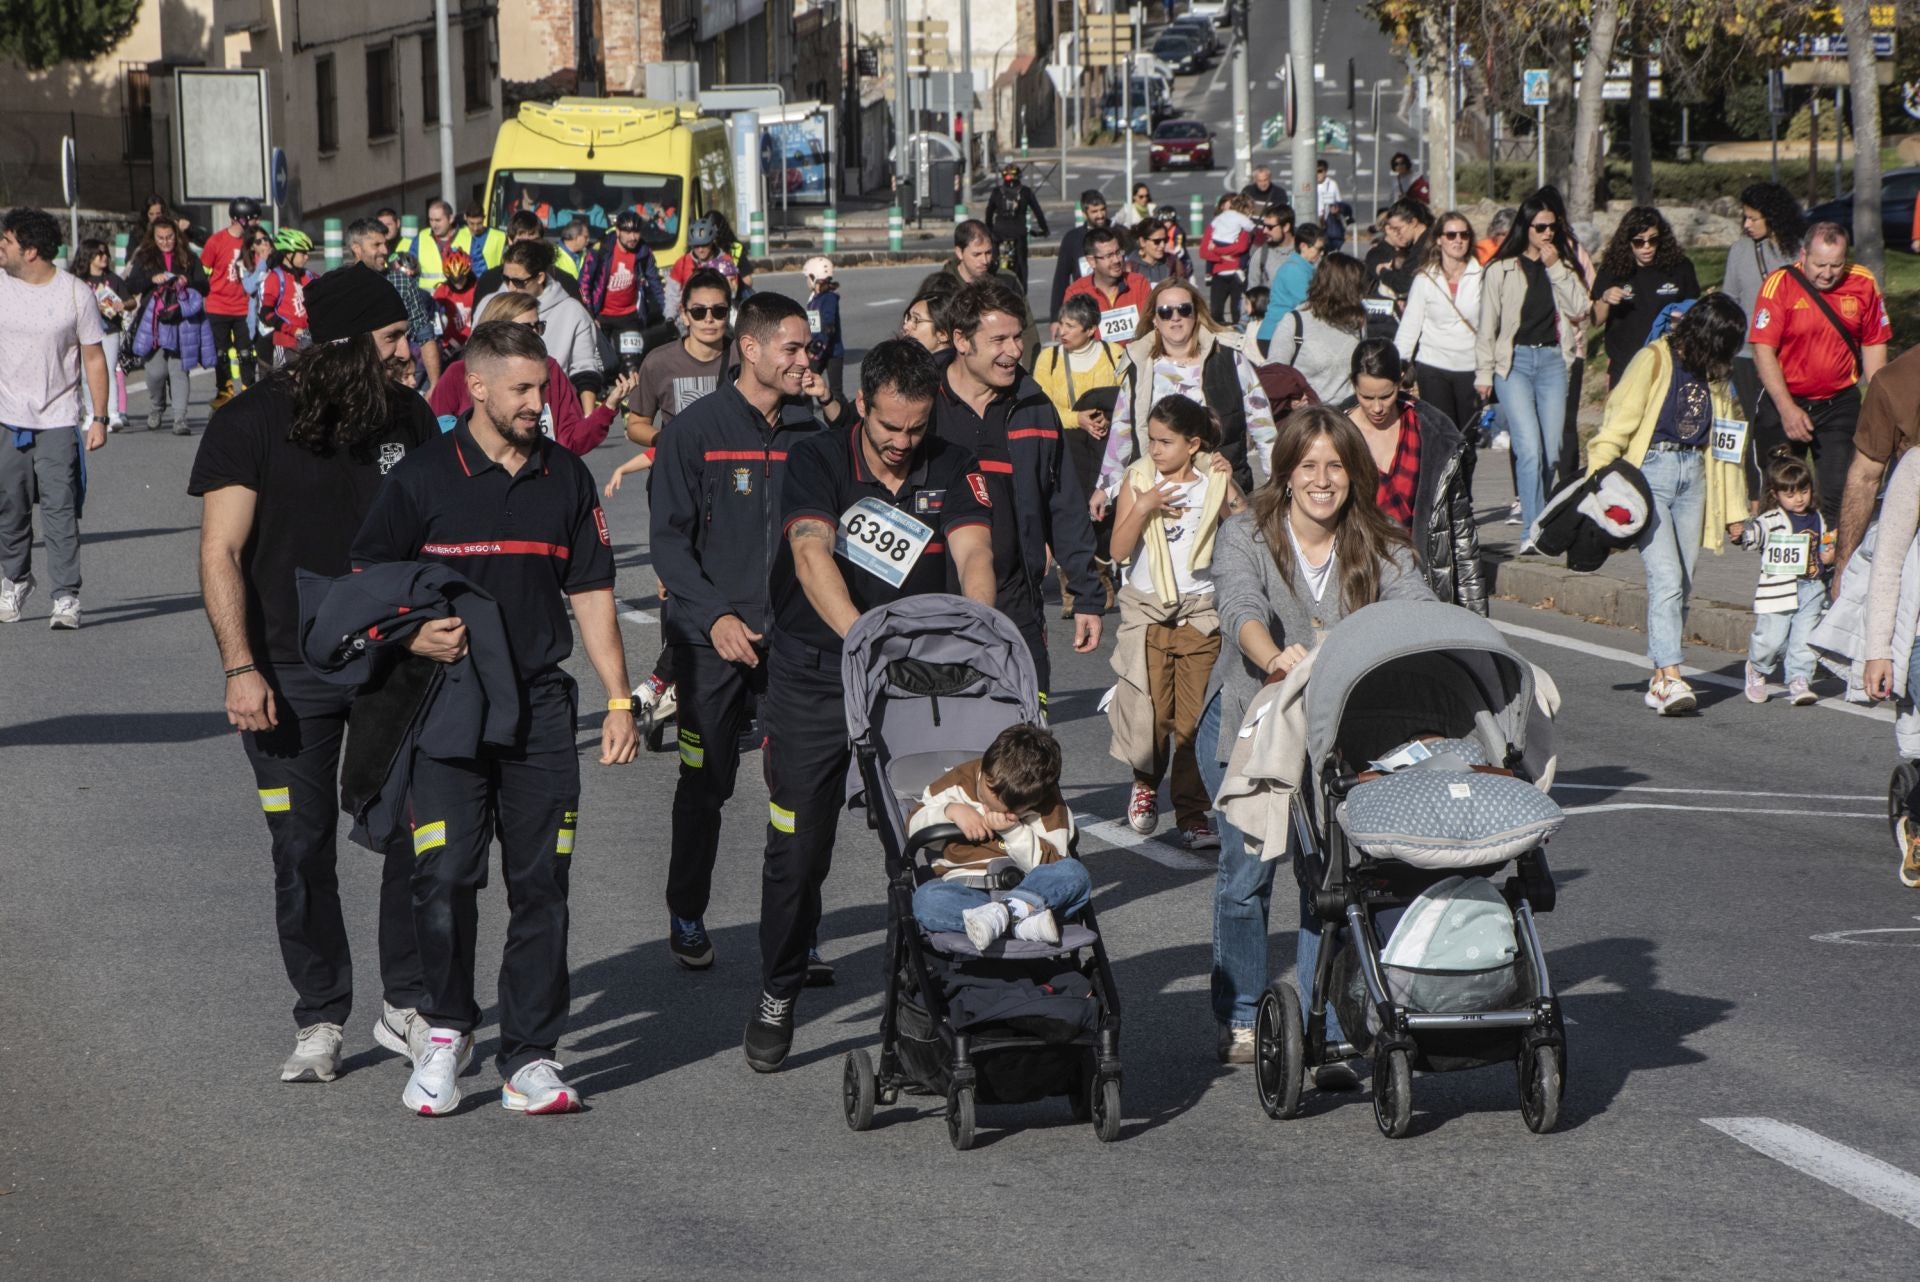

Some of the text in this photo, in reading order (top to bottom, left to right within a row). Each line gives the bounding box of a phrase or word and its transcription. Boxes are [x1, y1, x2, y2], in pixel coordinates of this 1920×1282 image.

[1105, 316, 1133, 335] 2331
[846, 513, 911, 562] 6398
[1767, 546, 1801, 564] 1985
